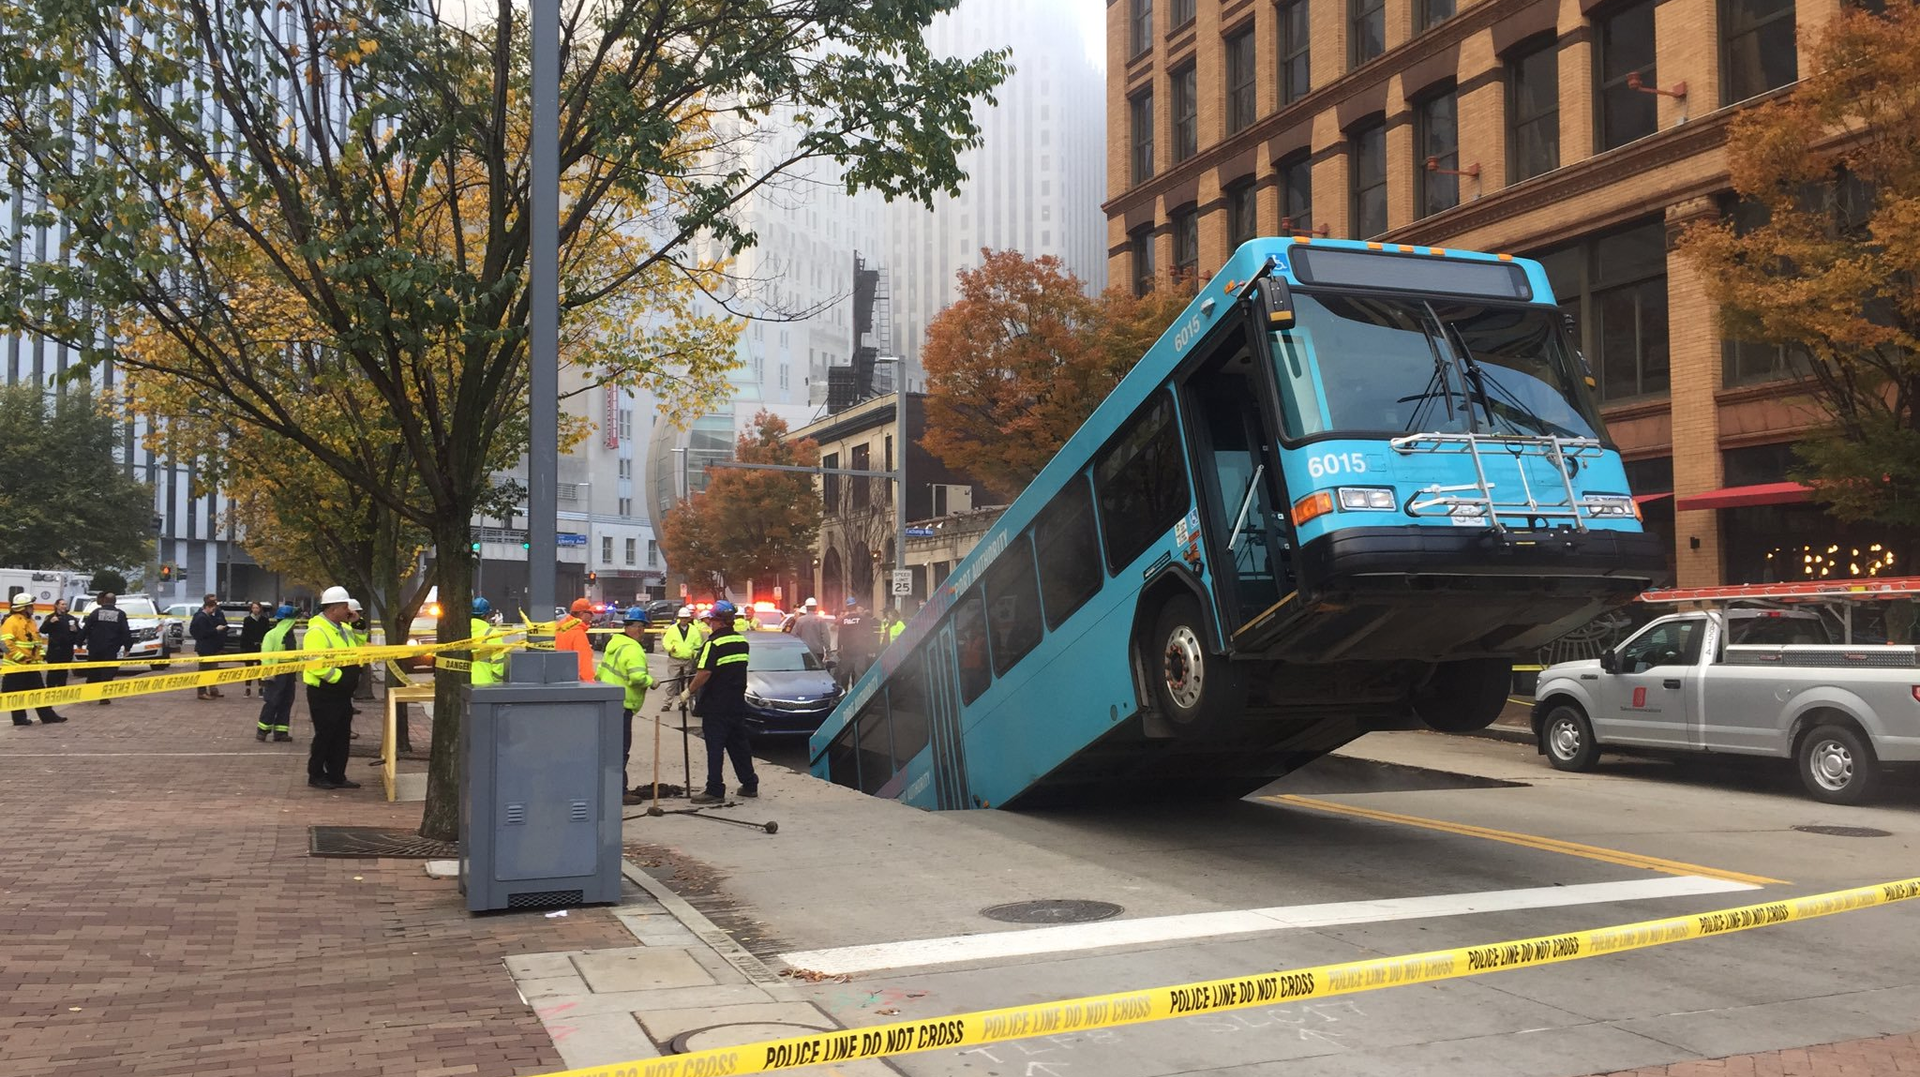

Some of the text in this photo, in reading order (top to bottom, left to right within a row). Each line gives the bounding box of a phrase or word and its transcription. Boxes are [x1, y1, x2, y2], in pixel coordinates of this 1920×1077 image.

[1174, 313, 1201, 352] 6015
[1308, 452, 1366, 478] 6015
[955, 528, 1008, 600] PORT AUTHORITY
[895, 582, 910, 593] 25
[1698, 904, 1789, 935] POLICE LINE DO NOT CROSS
[1468, 936, 1580, 971] POLICE LINE DO NOT CROSS
[1169, 973, 1315, 1014] POLICE LINE DO NOT CROSS
[982, 995, 1152, 1041] POLICE LINE DO NOT CROSS
[762, 1019, 965, 1070] POLICE LINE DO NOT CROSS
[683, 1052, 739, 1077] CROSS
